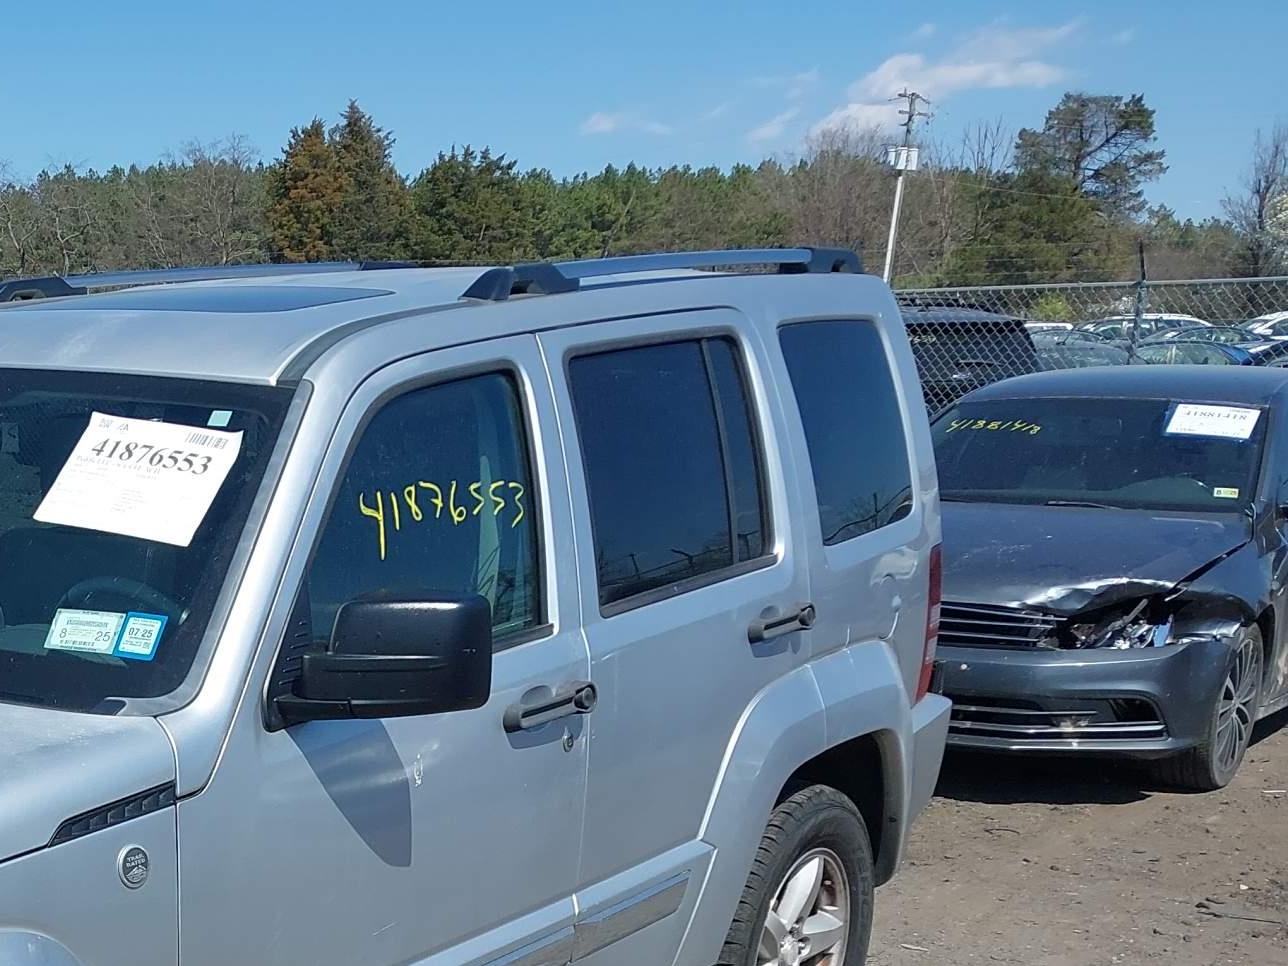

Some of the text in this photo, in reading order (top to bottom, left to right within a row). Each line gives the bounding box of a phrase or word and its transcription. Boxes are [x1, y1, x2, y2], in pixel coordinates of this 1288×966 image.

[91, 438, 214, 476] 41876553
[359, 480, 525, 561] 41876553
[94, 630, 111, 642] 25
